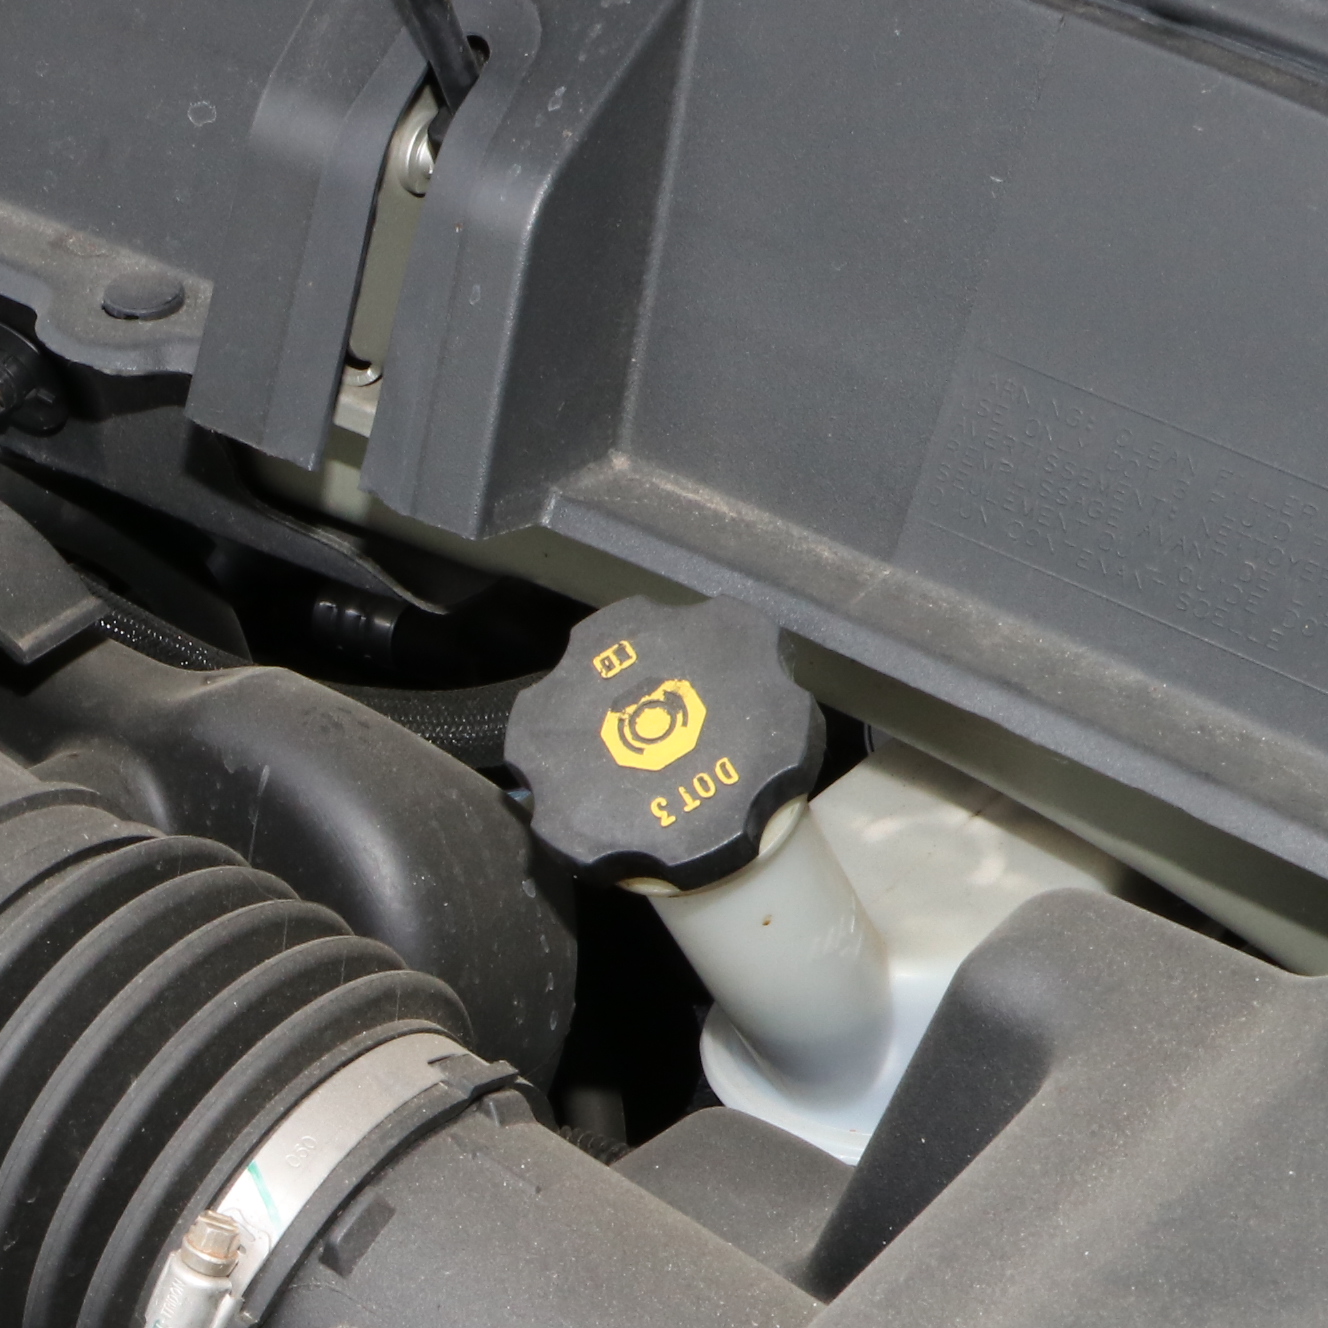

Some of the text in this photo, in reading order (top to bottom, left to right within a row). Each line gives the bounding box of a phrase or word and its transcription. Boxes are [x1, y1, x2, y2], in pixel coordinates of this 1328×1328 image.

[958, 389, 1010, 426] USE
[650, 757, 741, 828] DOT 3
